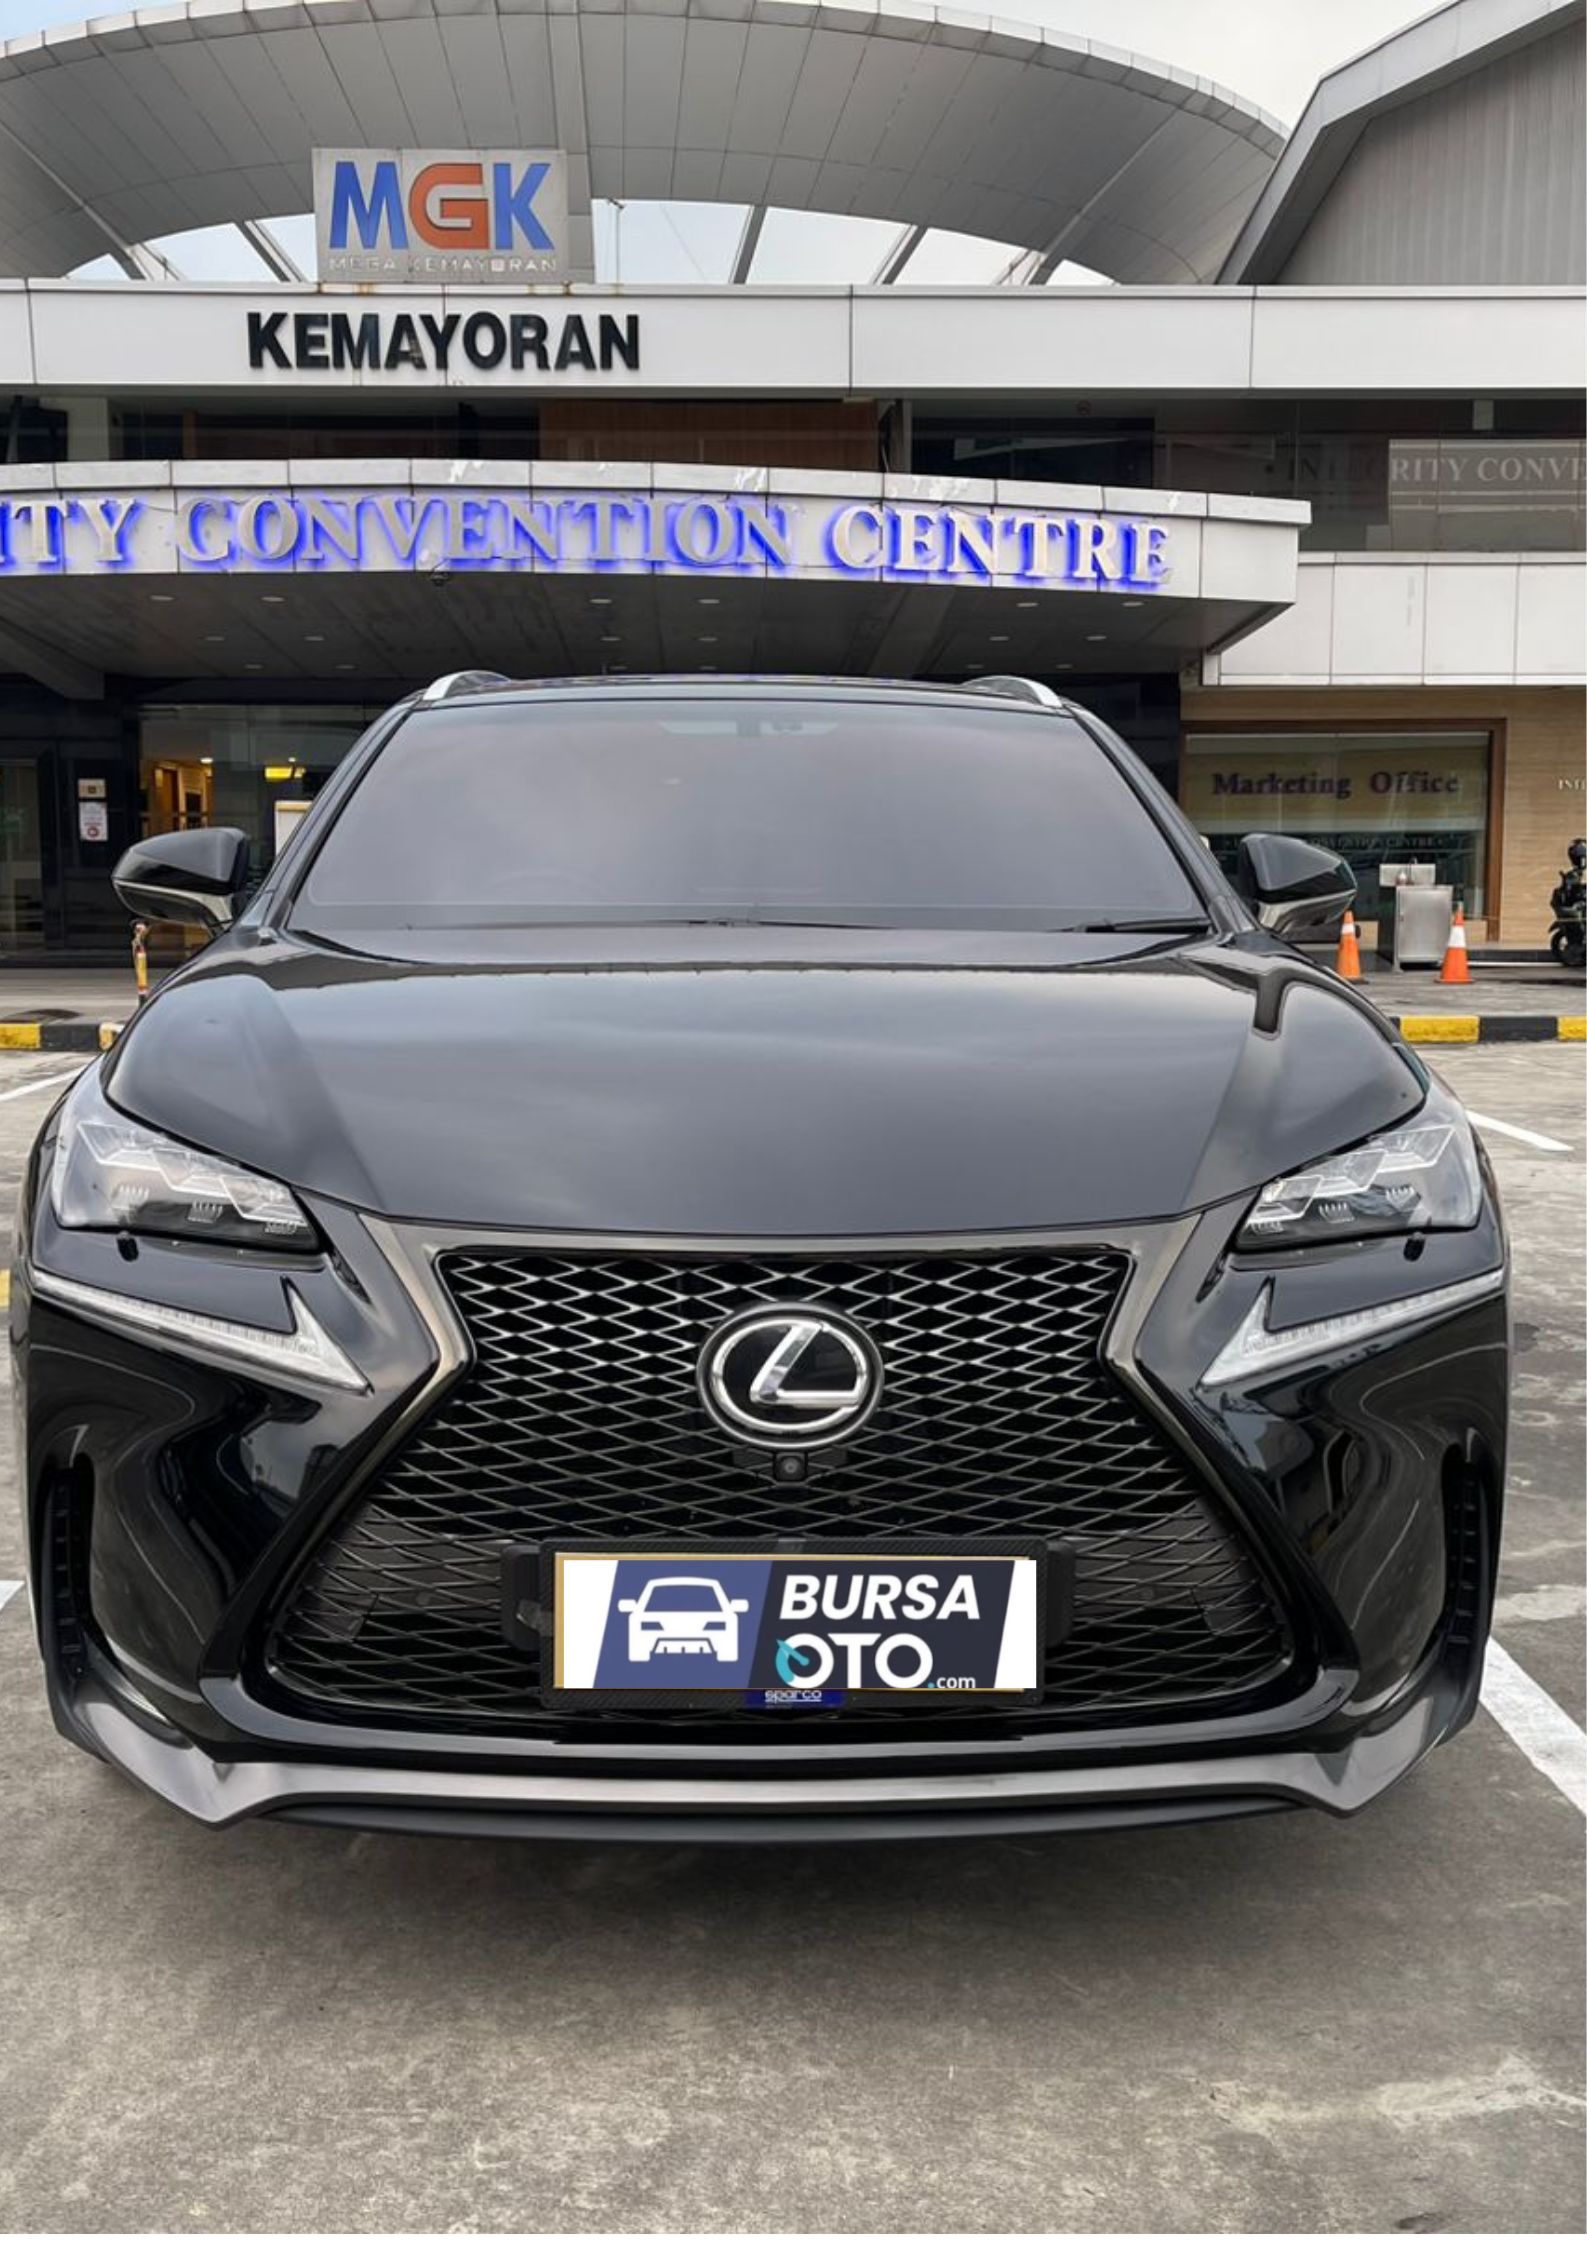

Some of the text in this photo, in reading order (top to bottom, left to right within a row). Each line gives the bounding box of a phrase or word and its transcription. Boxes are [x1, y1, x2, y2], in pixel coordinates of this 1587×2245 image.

[329, 161, 555, 251] MGK
[329, 257, 396, 272] MEGA
[247, 311, 640, 370] KEMAYORAN
[175, 494, 794, 567] CONVENTION
[831, 505, 1170, 585] CENTRE
[1212, 772, 1459, 799] Marketing Office
[765, 1690, 822, 1703] sparco
